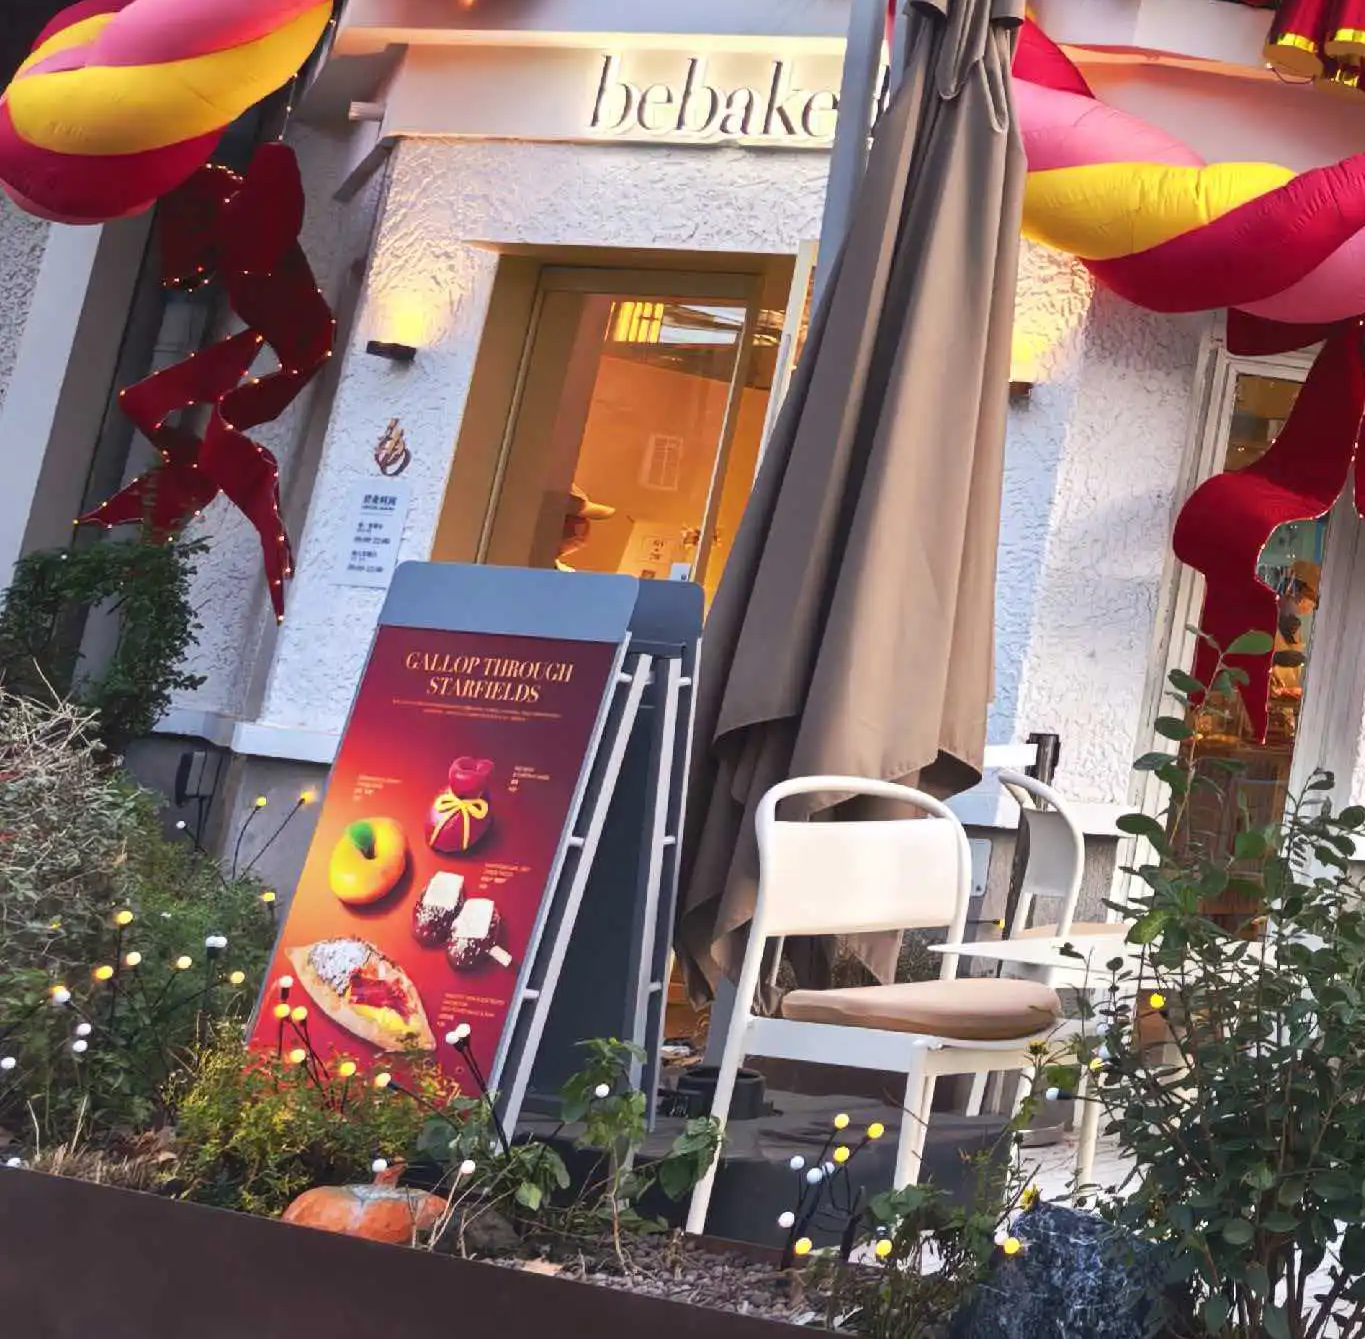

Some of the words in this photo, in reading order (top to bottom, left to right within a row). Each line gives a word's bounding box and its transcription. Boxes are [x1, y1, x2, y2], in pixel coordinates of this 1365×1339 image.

[405, 651, 480, 675] GALLOP
[483, 657, 575, 683] THROUGH
[426, 675, 542, 703] STARFIELDS
